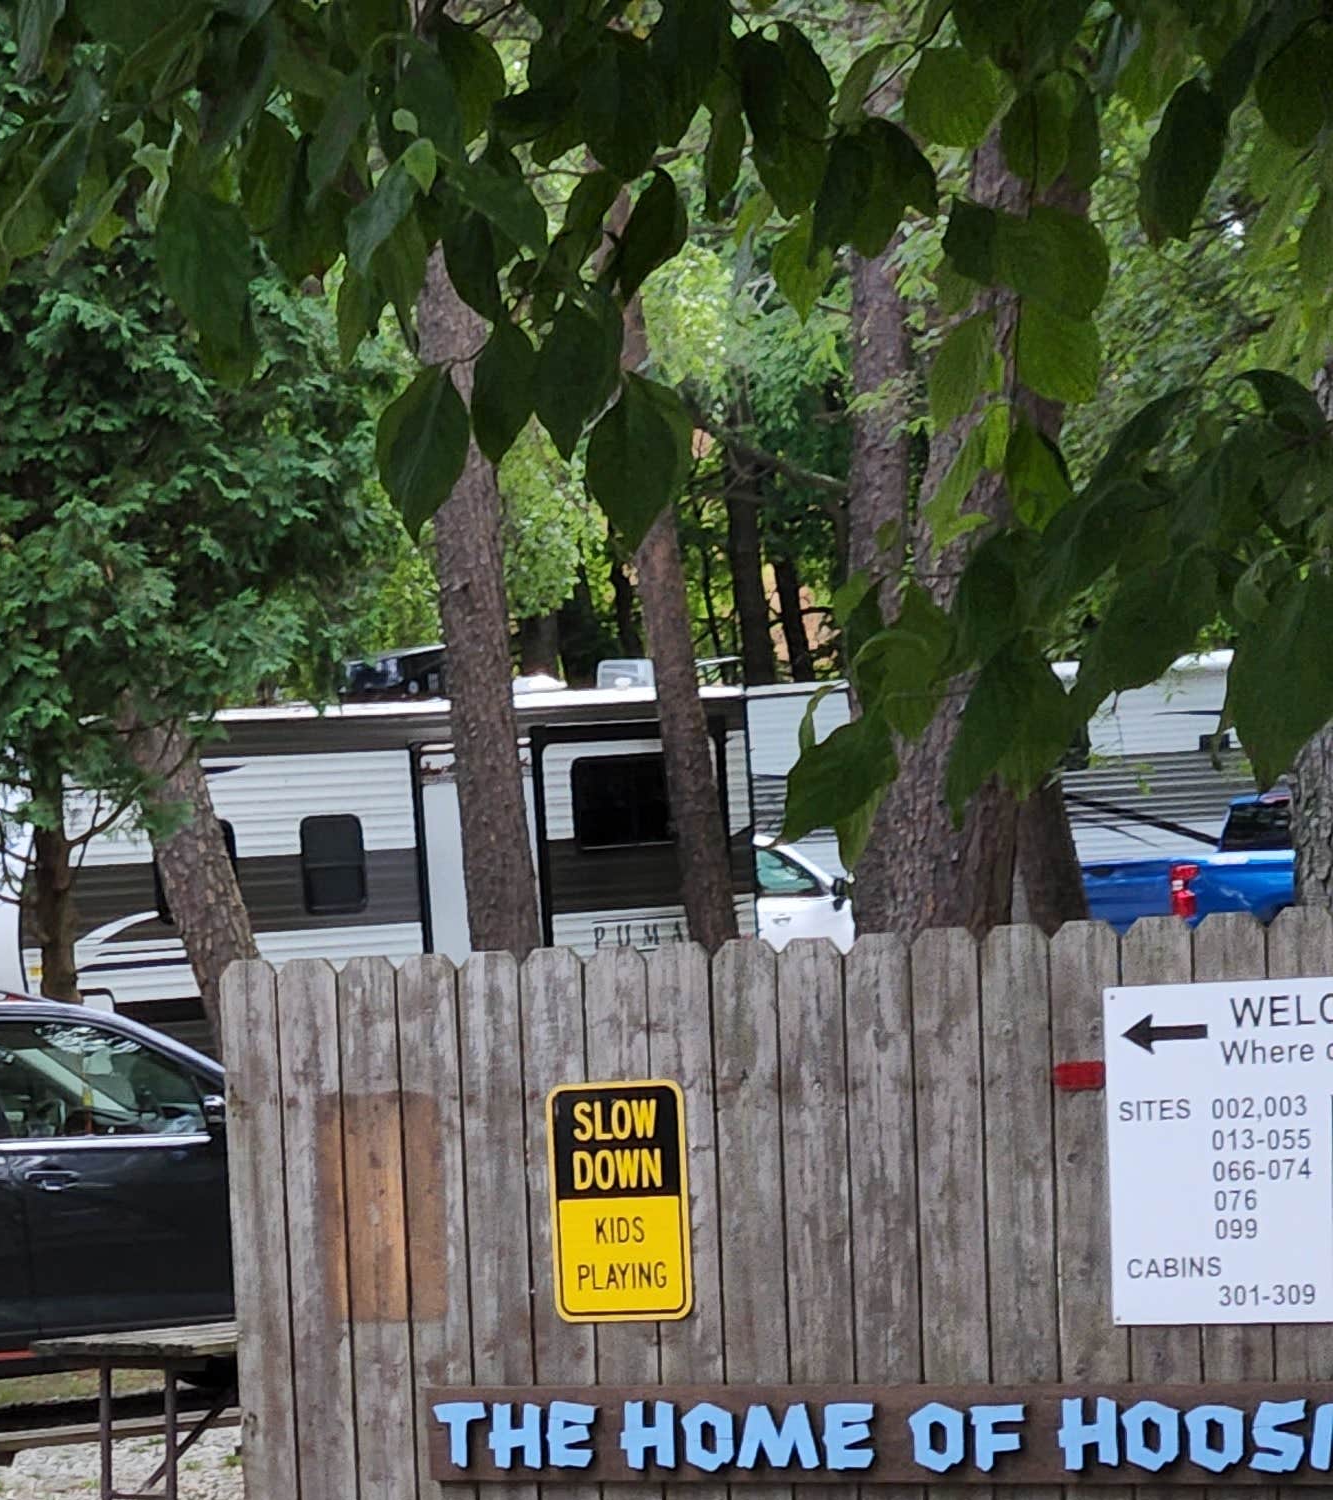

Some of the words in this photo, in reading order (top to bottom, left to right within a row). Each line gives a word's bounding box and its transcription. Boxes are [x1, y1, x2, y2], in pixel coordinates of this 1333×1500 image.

[593, 920, 684, 949] PUMA
[1220, 1039, 1314, 1065] Where
[572, 1098, 657, 1142] SLOW
[1118, 1098, 1192, 1122] SITES
[1211, 1094, 1308, 1121] 002,003
[1211, 1127, 1312, 1151] 013-055
[571, 1148, 663, 1191] DOWN
[1211, 1157, 1313, 1182] 066-074
[1213, 1188, 1258, 1212] 076
[594, 1216, 645, 1244] KIDS
[1214, 1218, 1259, 1240] 099
[577, 1261, 668, 1291] PLAYING
[1126, 1256, 1223, 1279] CABINS
[1217, 1283, 1317, 1308] 301-309
[433, 1400, 597, 1470] THE
[619, 1400, 876, 1473] HOME
[907, 1401, 1026, 1474] OF
